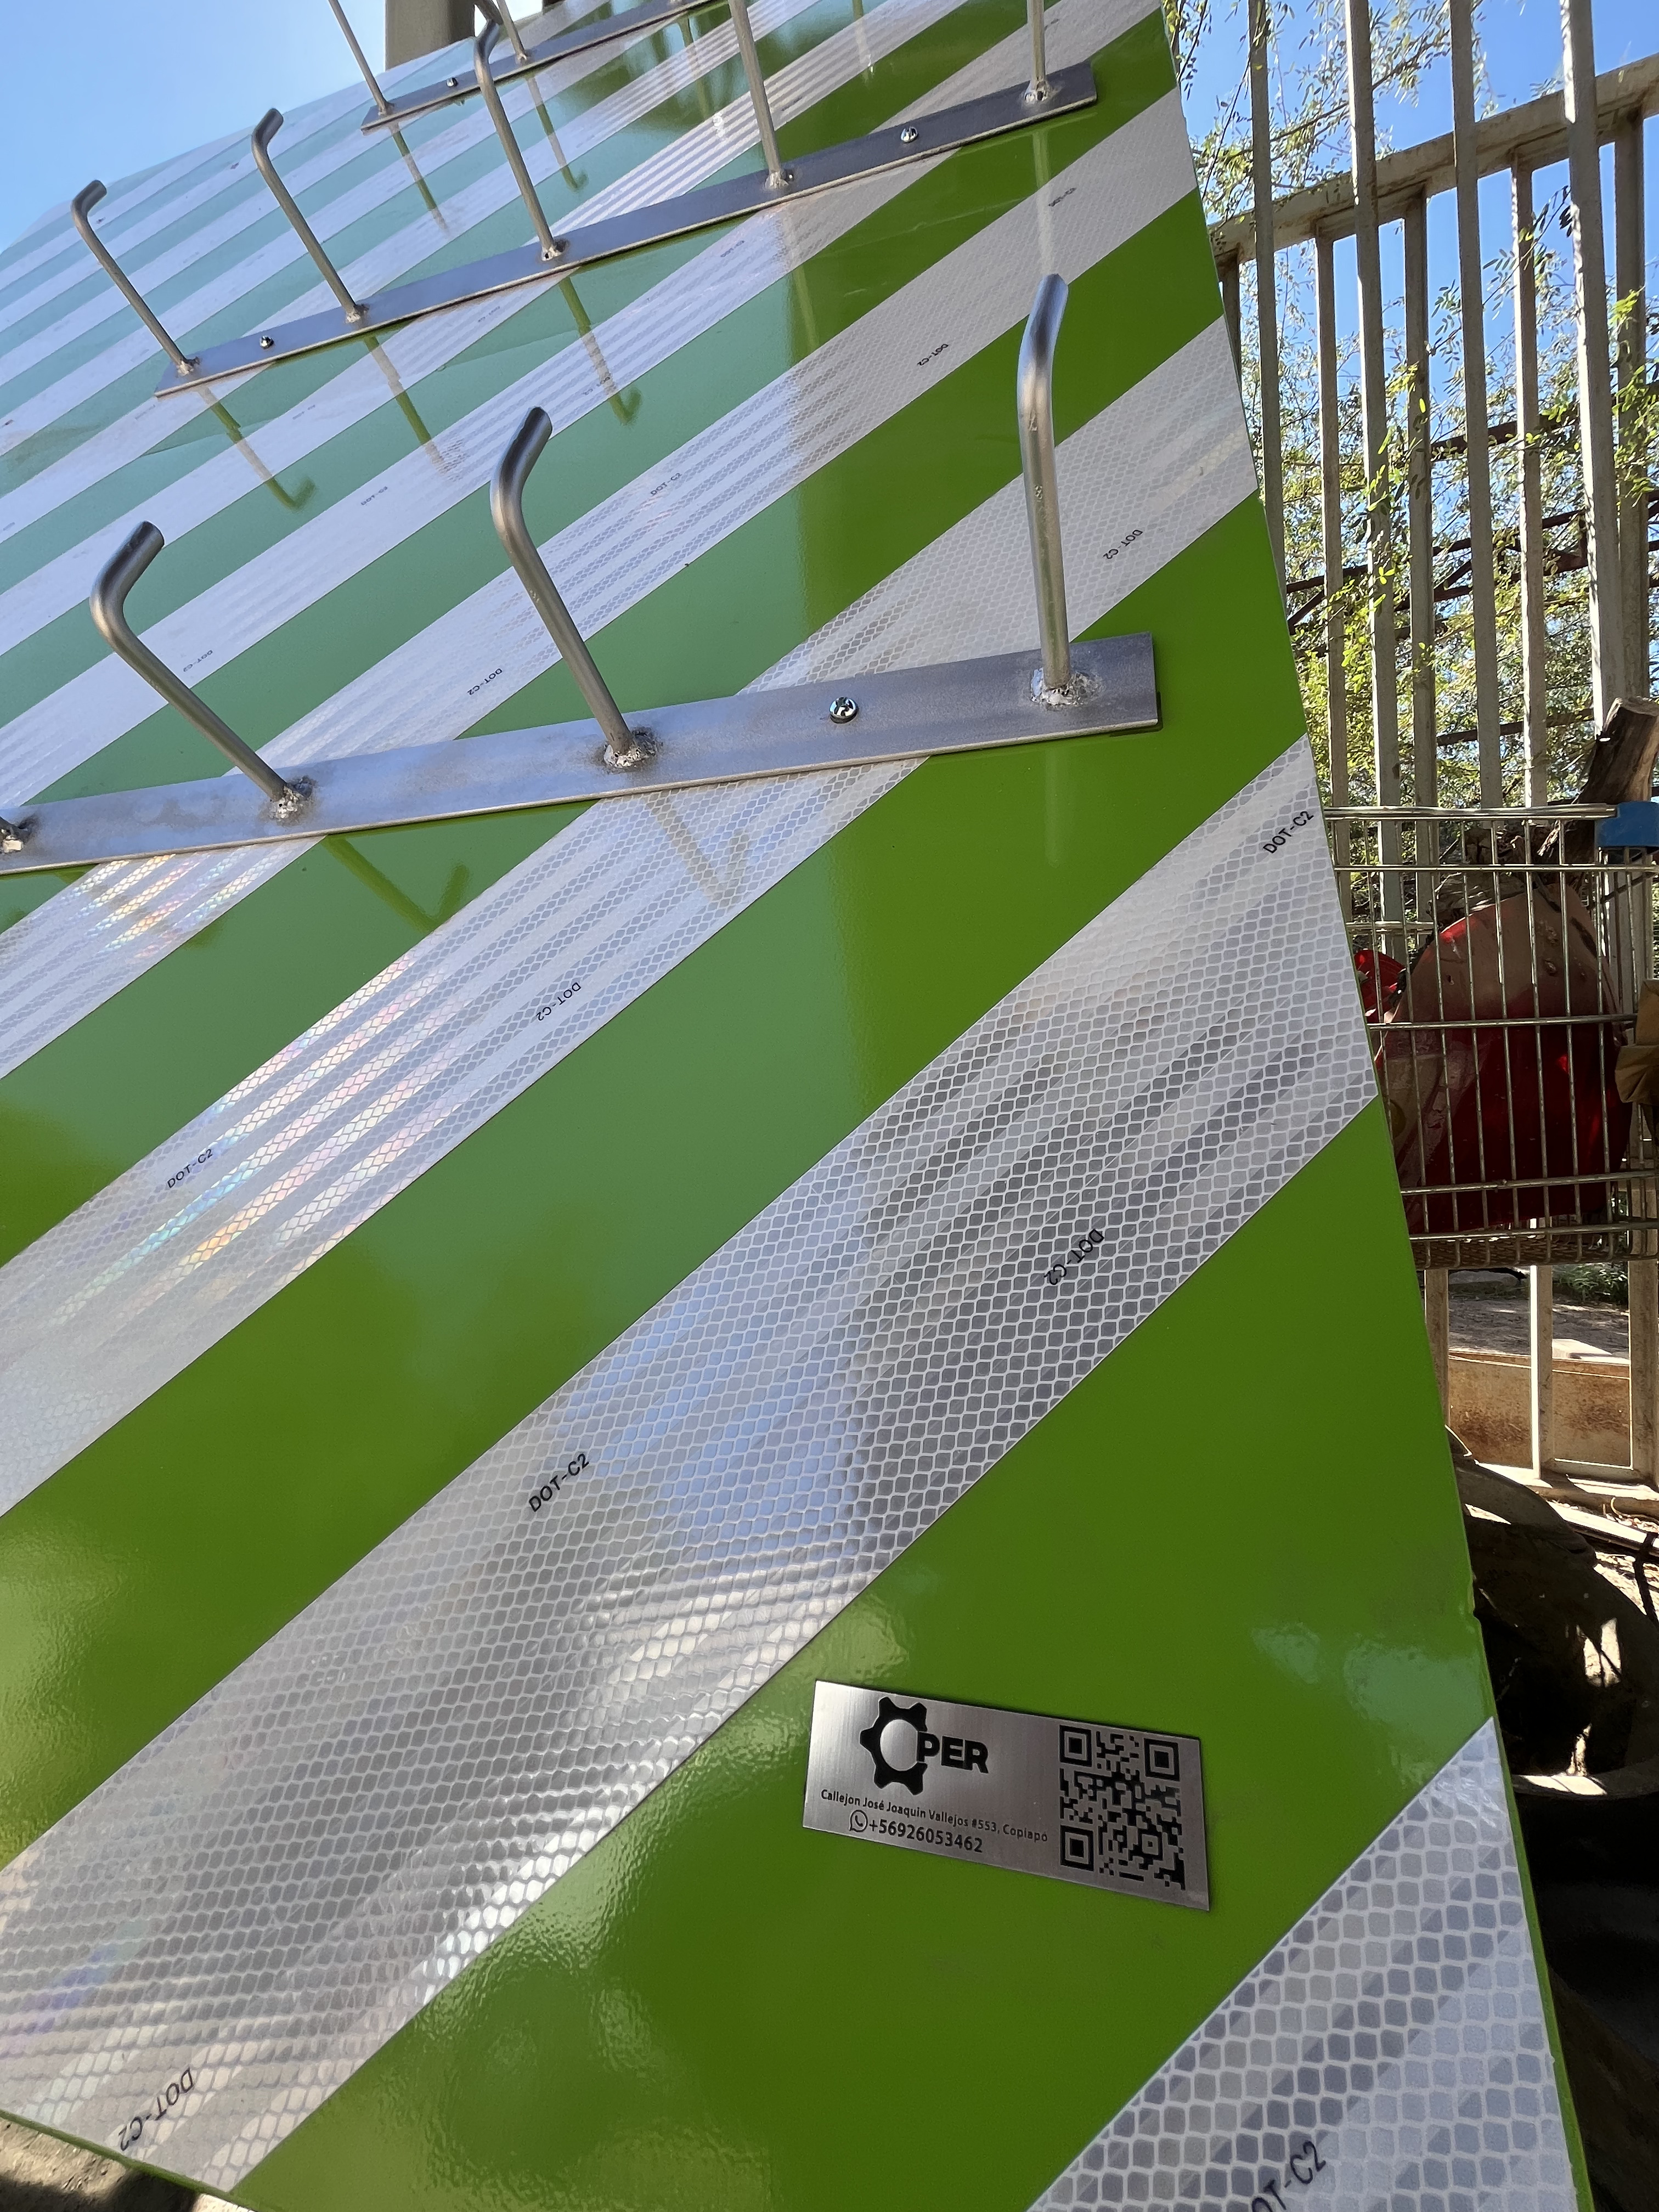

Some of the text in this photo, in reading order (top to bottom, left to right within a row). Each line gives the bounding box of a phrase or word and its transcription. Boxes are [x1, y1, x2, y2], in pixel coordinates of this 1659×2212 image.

[650, 472, 682, 496] DOT-C2
[1103, 529, 1143, 560] DOT-C2
[467, 668, 503, 696] DOT-C2
[1262, 810, 1314, 854] DOT-C2
[535, 981, 582, 1022] DOT-C2
[167, 1148, 214, 1189] DOT-C2
[1043, 1228, 1104, 1285] DOT-C2
[528, 1453, 590, 1513] DOT-C2
[821, 1788, 860, 1807] Callejon
[862, 1797, 884, 1811] José
[928, 1809, 968, 1827] Vallejos
[868, 1818, 983, 1853] +56926053462
[117, 2067, 195, 2152] DOT-C2
